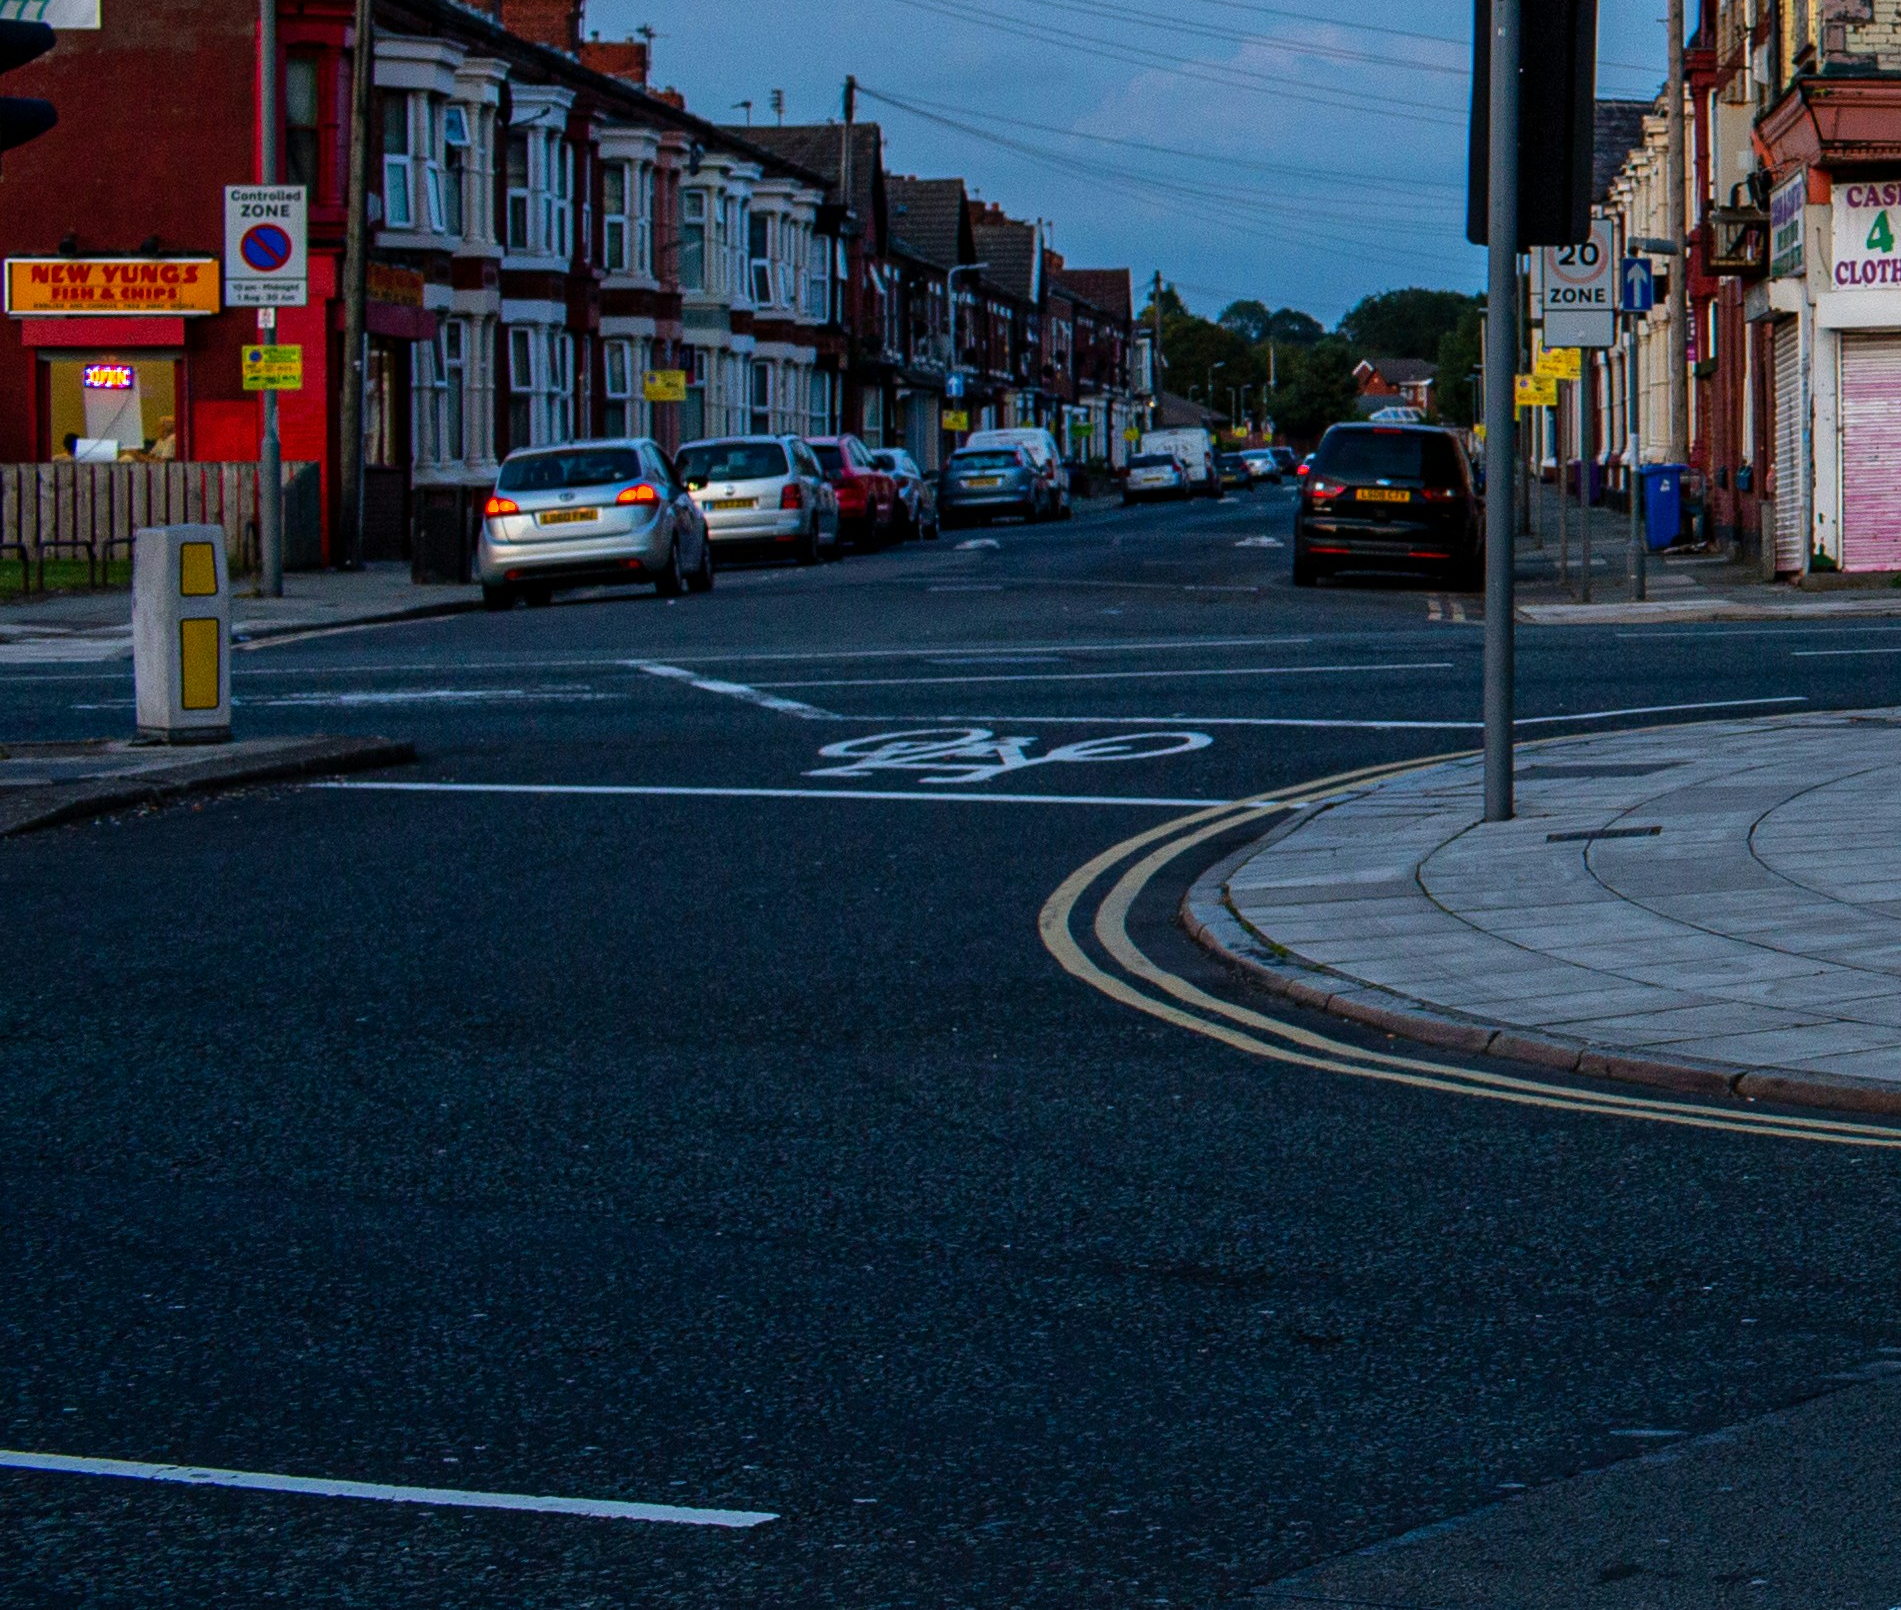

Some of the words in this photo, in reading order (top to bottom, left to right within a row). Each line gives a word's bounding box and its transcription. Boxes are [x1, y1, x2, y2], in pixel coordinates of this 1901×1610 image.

[231, 190, 301, 201] Controlled
[241, 204, 291, 218] ZONE
[1866, 209, 1894, 253] 4
[1558, 242, 1600, 266] 20
[31, 265, 92, 284] NEW
[102, 265, 199, 284] YUNGS
[52, 287, 95, 300] FISH
[100, 287, 114, 300] &
[121, 287, 178, 301] CHIPS
[1550, 288, 1606, 303] ZONE
[90, 370, 126, 384] OPEN
